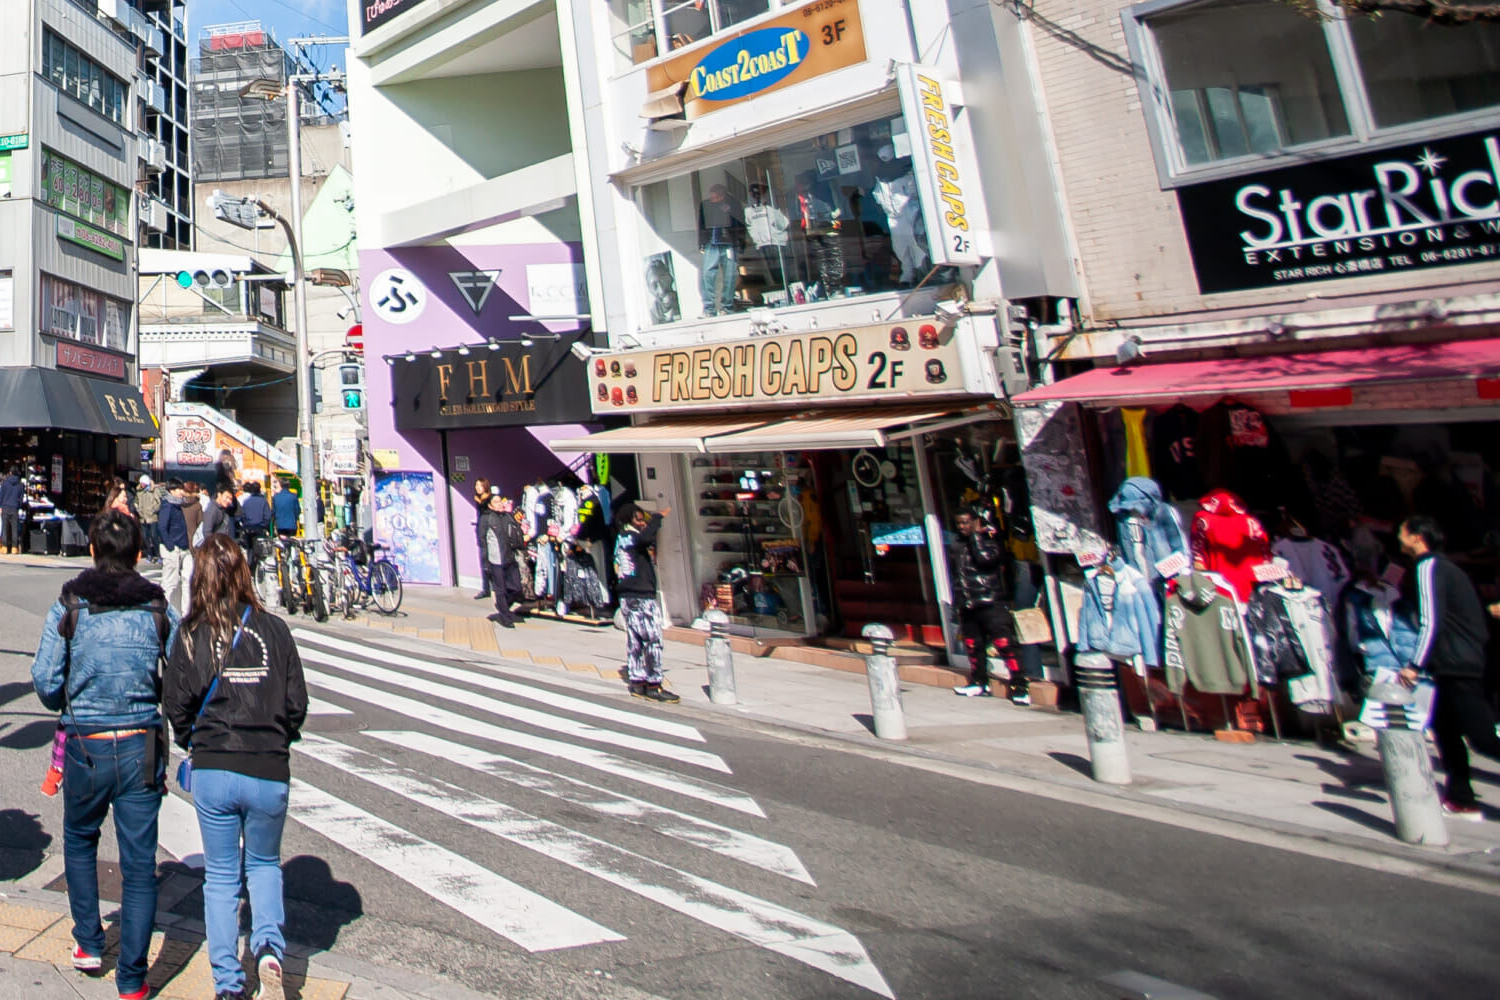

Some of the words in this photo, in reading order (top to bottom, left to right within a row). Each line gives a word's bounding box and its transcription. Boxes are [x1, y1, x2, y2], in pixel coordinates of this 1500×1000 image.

[822, 19, 846, 46] 3F
[917, 74, 955, 162] FRESH
[935, 161, 969, 232] CAPS
[953, 235, 971, 253] 2F
[1244, 227, 1444, 265] EXTENSION
[1453, 225, 1470, 240] &
[1273, 268, 1303, 281] STAR
[1305, 265, 1332, 278] RICH
[1389, 254, 1412, 267] TEL
[377, 275, 419, 313] ふ
[652, 344, 756, 402] FRESH
[760, 332, 858, 396] CAPS
[867, 351, 904, 390] 2F
[463, 402, 508, 415] HOLLYWOOD
[509, 399, 536, 412] STYLE
